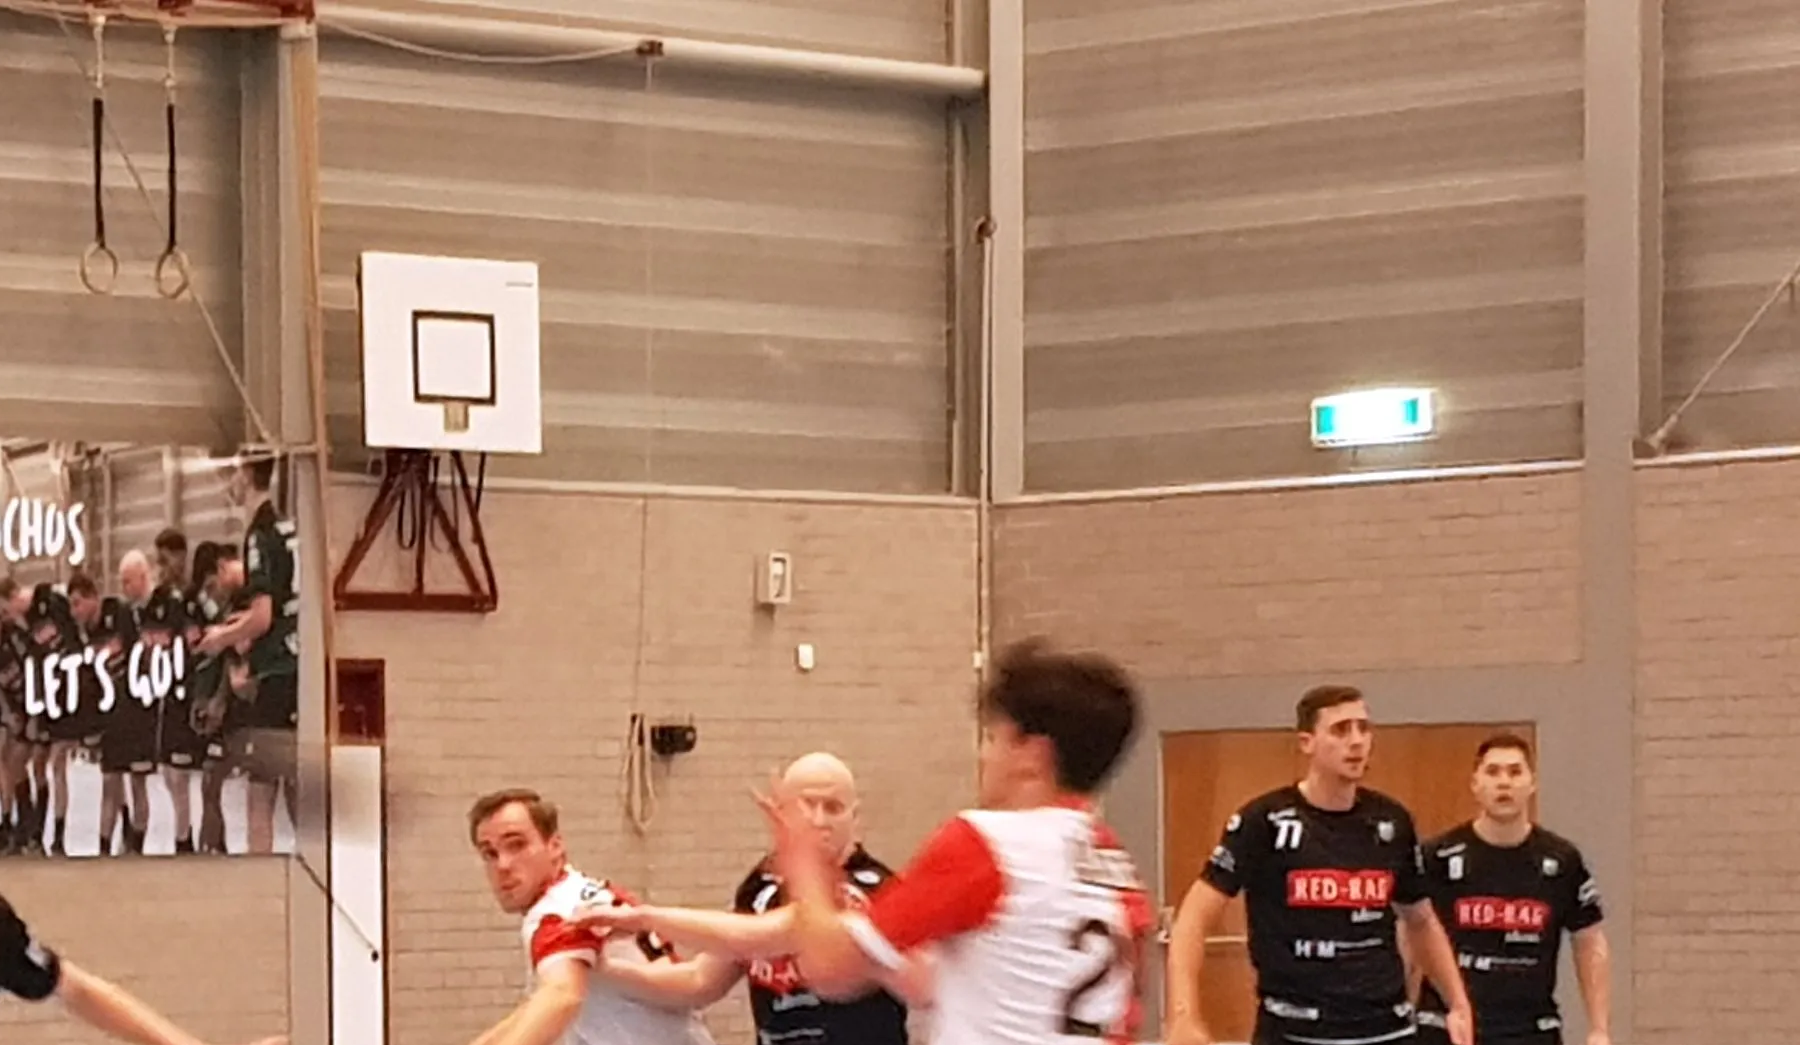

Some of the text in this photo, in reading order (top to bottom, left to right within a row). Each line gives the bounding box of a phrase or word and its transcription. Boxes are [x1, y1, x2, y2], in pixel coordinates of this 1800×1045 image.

[23, 634, 187, 721] LET'S GO!
[1274, 818, 1303, 849] 77
[1067, 917, 1114, 1036] 2
